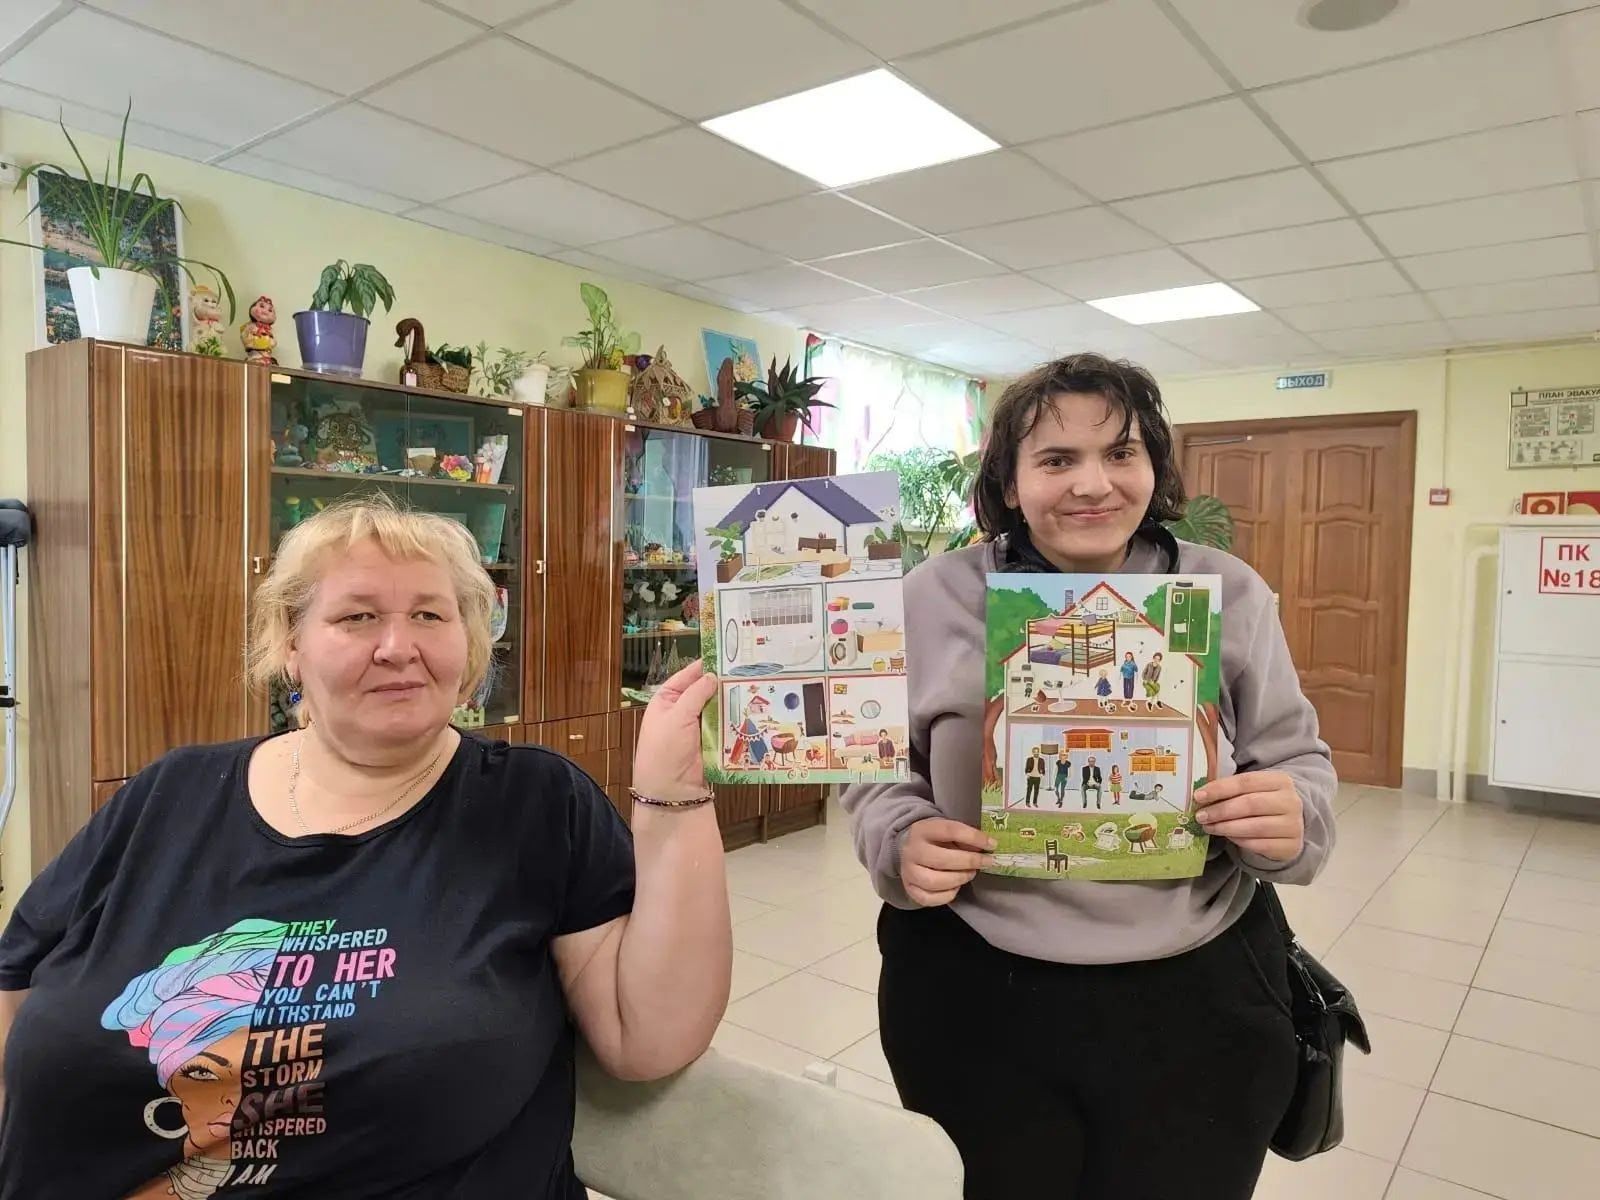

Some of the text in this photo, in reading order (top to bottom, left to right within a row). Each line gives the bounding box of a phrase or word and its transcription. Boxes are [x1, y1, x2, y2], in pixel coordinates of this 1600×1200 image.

[1279, 375, 1323, 389] ВЫХОД
[1538, 391, 1564, 399] ПЛАН
[1558, 544, 1590, 561] ПК
[1543, 568, 1600, 589] №18
[289, 919, 337, 936] THEY
[281, 928, 388, 952] WHISPERED
[273, 948, 396, 988] TO HER
[262, 980, 381, 1006] YOU CAN'T
[253, 1002, 356, 1026] WITHSTAND
[249, 1023, 326, 1066] THE
[243, 1059, 323, 1088] STORM
[233, 1082, 326, 1129] SHE
[231, 1139, 280, 1160] BACK
[231, 1164, 278, 1186] AM
